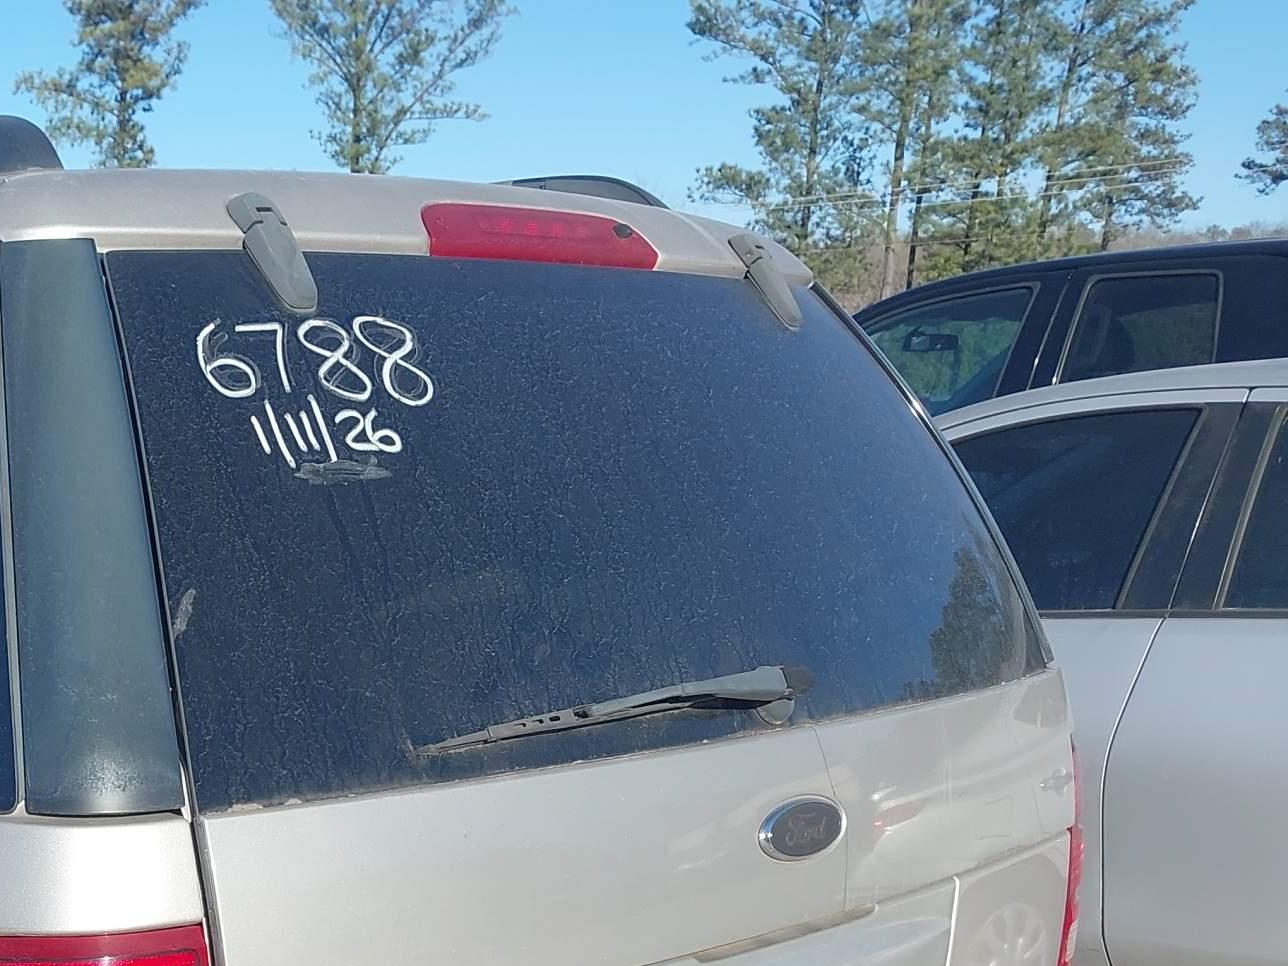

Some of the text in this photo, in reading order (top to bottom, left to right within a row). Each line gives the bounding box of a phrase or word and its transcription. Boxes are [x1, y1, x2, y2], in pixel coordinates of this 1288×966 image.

[196, 315, 434, 406] 6788
[250, 394, 403, 469] 1/11/26
[785, 812, 827, 847] Ford
